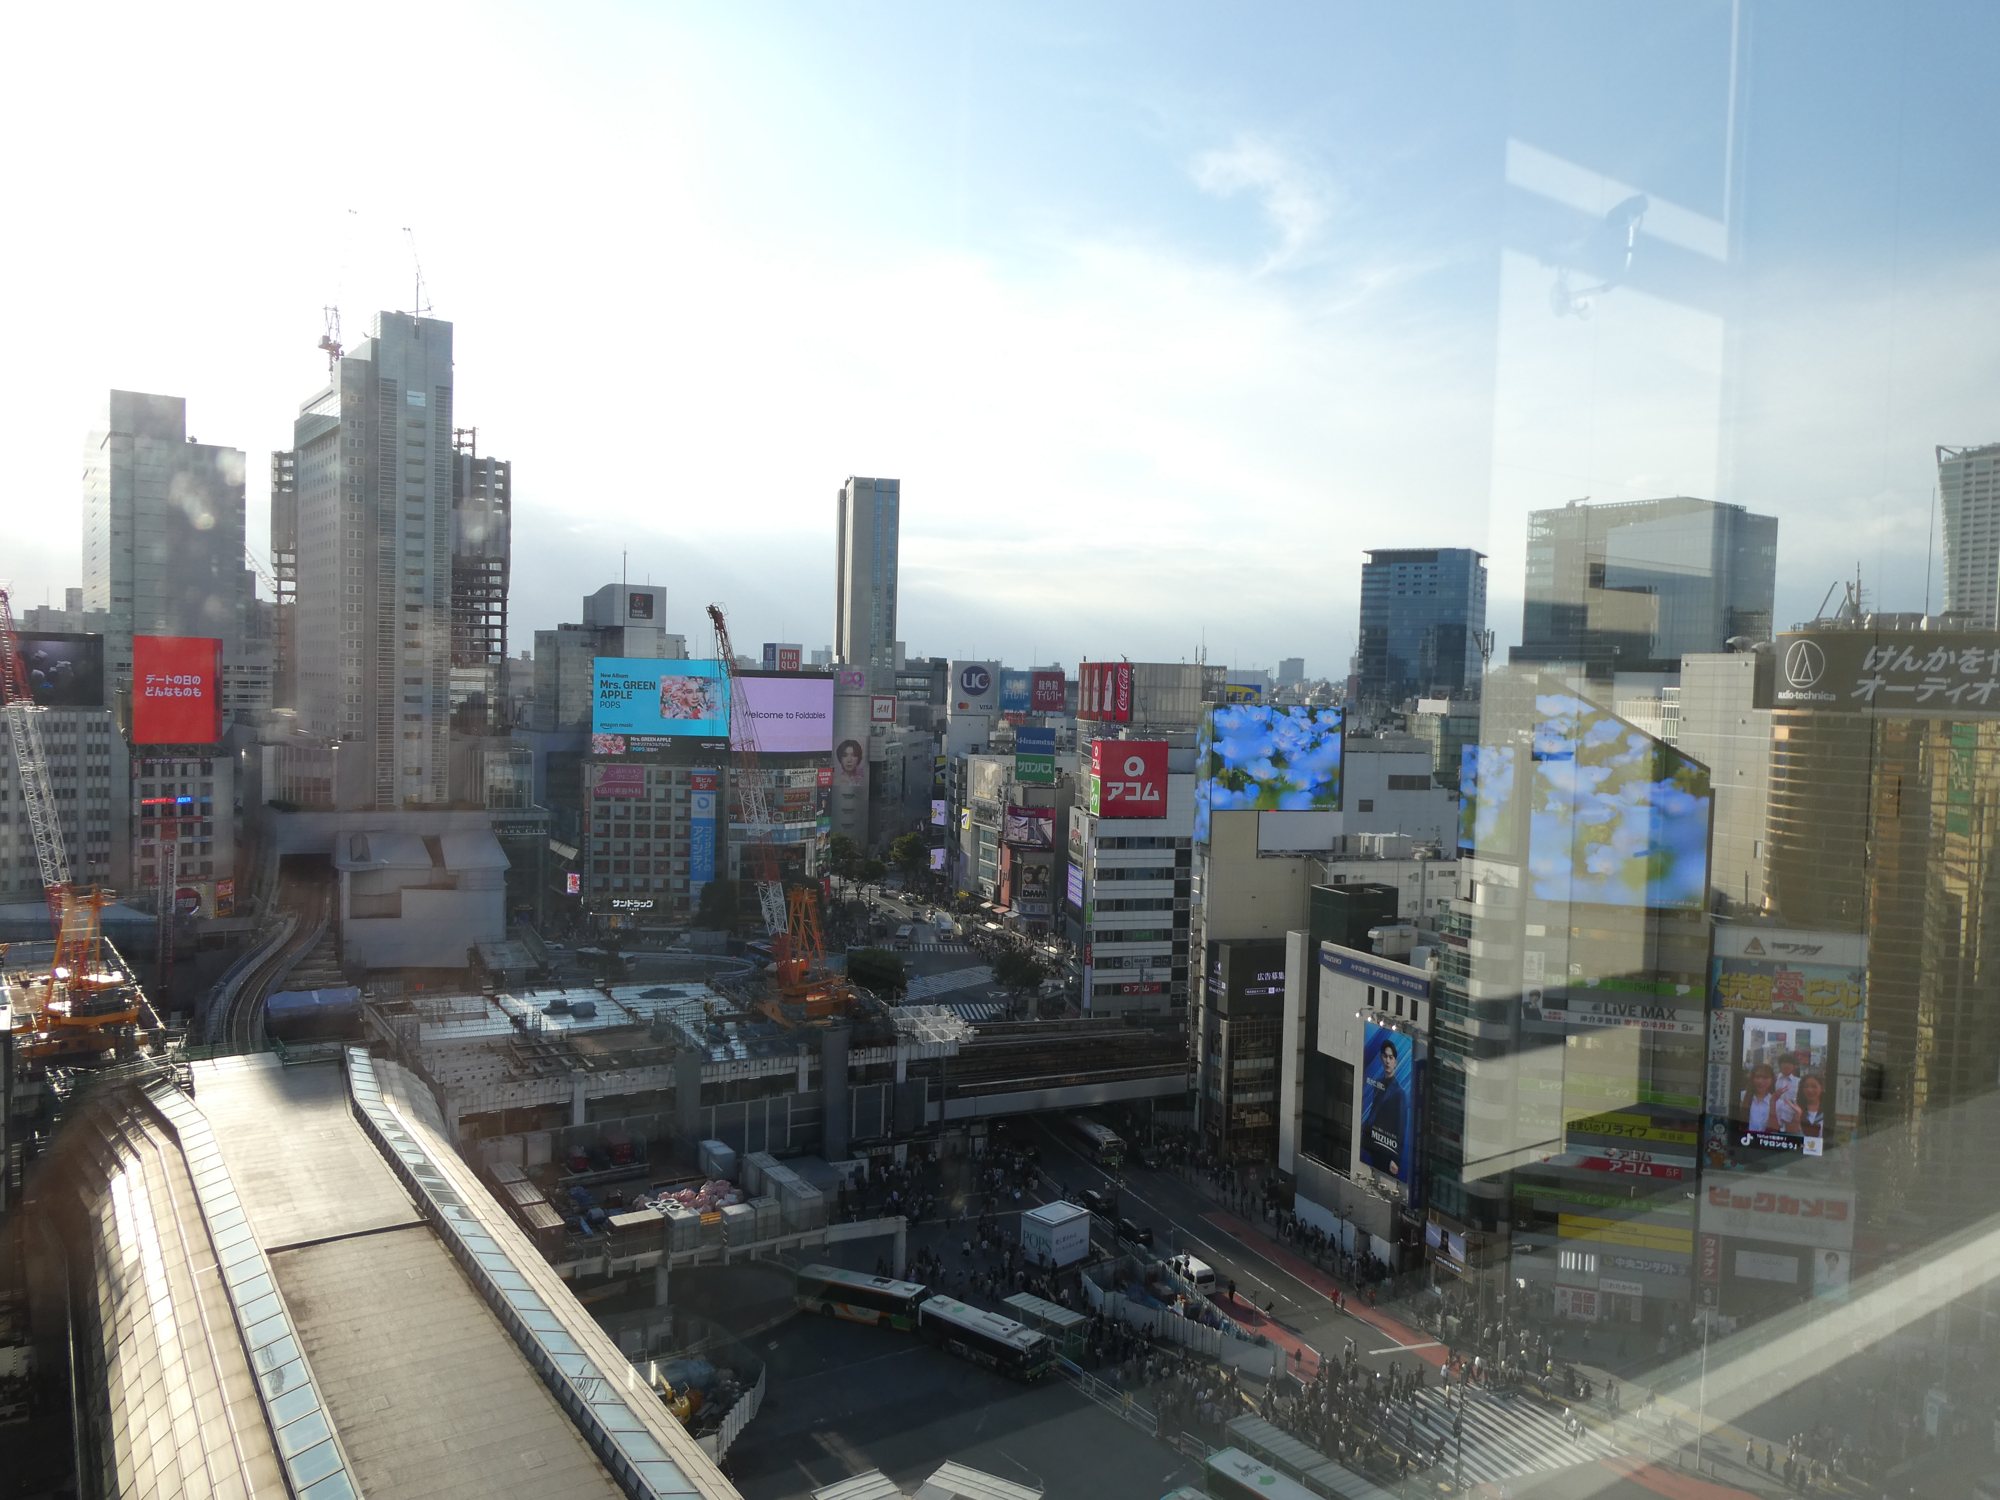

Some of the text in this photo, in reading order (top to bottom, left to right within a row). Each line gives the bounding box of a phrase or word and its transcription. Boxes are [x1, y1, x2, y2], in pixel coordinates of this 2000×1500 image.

[145, 674, 202, 685] デートの日の
[600, 680, 656, 690] Mrs. GREEN
[962, 673, 988, 689] UC
[145, 687, 202, 697] どんなものも
[600, 691, 632, 700] APPLE
[1117, 668, 1129, 711] Coca-Cola
[1778, 690, 1836, 701] audio-technica
[796, 712, 826, 720] Foldables
[1018, 761, 1052, 774] サロンパス
[1106, 782, 1160, 800] アコム
[612, 900, 654, 908] サンドラッグ
[1641, 1006, 1676, 1020] MAX
[1371, 1130, 1398, 1149] MIZUHO
[1608, 1160, 1652, 1176] アコム
[1709, 1184, 1848, 1220] ビックカメラ
[1704, 1238, 1716, 1276] カラオケ
[1615, 1256, 1676, 1274] 中央コンタクト
